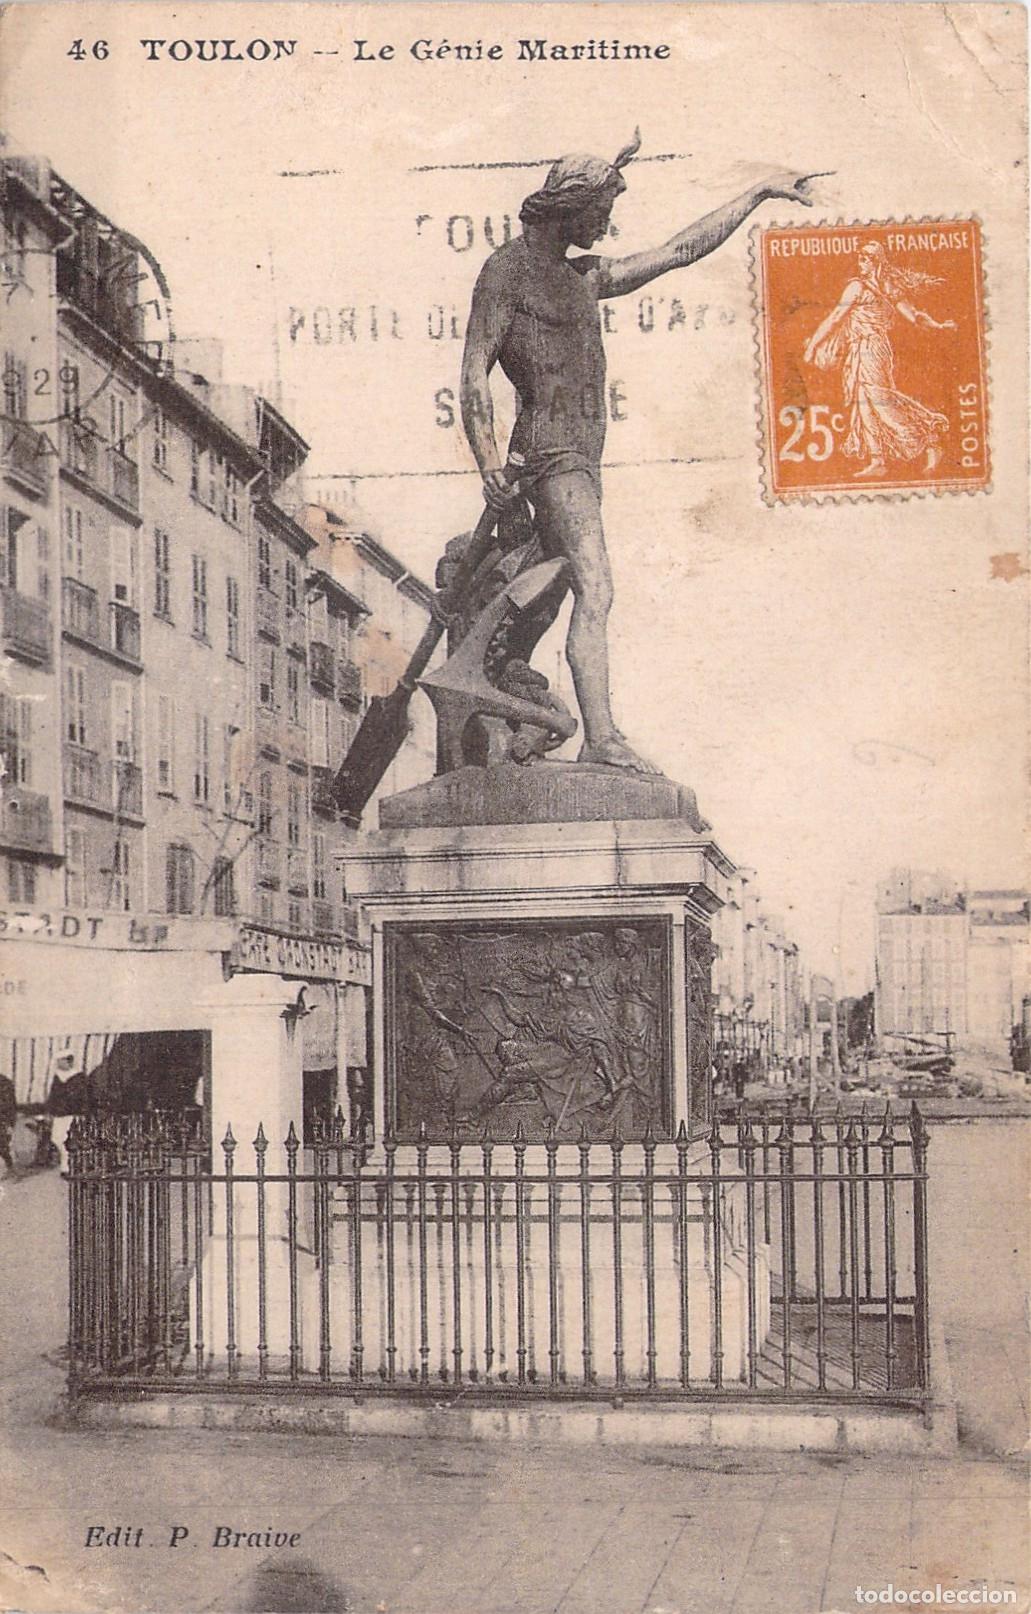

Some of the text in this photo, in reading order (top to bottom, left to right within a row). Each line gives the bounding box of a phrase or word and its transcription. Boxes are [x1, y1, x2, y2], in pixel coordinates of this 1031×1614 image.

[67, 39, 671, 61] 46 TOULON Le Génie Maritime
[770, 231, 969, 257] REPUBLIQUE FRANÇAISE
[958, 382, 980, 468] POSTES
[212, 1526, 302, 1548] Braive
